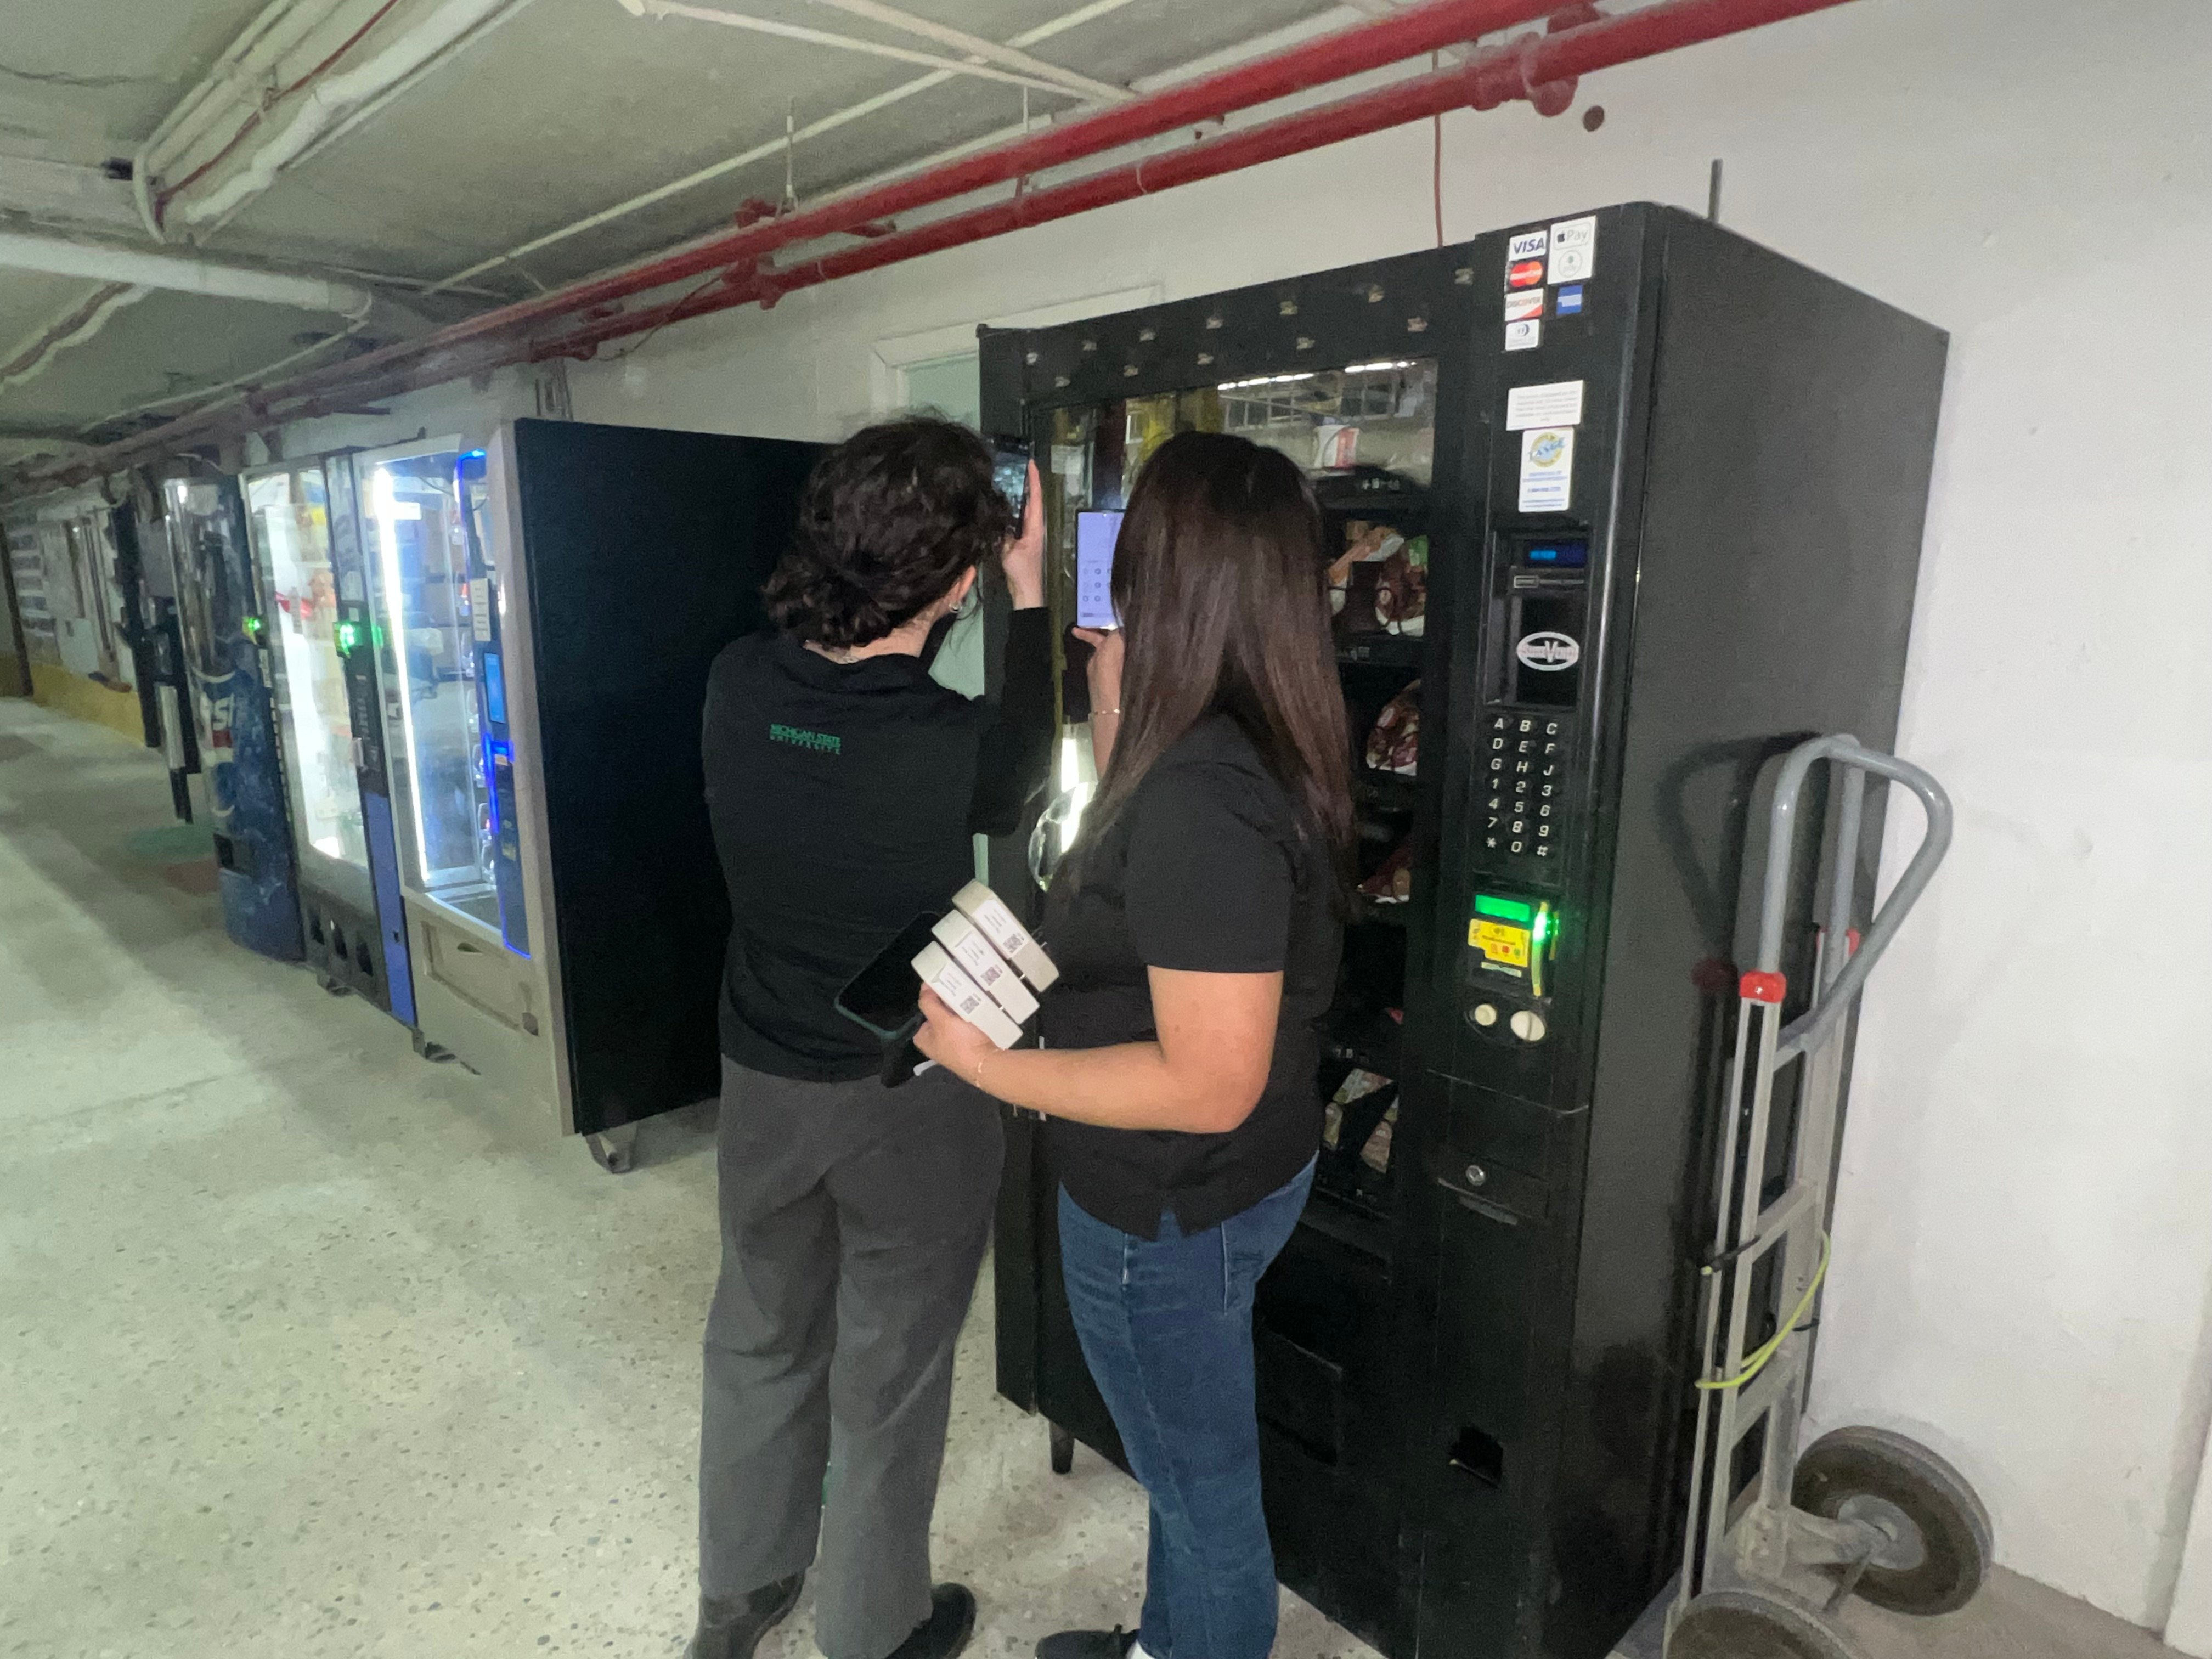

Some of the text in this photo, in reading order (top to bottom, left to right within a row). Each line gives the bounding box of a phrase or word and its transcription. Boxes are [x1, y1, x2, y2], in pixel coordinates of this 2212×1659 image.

[1566, 229, 1588, 244] Pay
[1513, 237, 1545, 255] VISA
[1494, 718, 1557, 735] A B C
[1492, 738, 1555, 754] D E F
[1491, 758, 1553, 776] G H J
[1492, 778, 1552, 796] 1 2 3
[1488, 798, 1550, 816] 4 5 6
[1487, 817, 1549, 837] 7 8 9
[1511, 840, 1522, 853] 0
[1537, 845, 1548, 856] #
